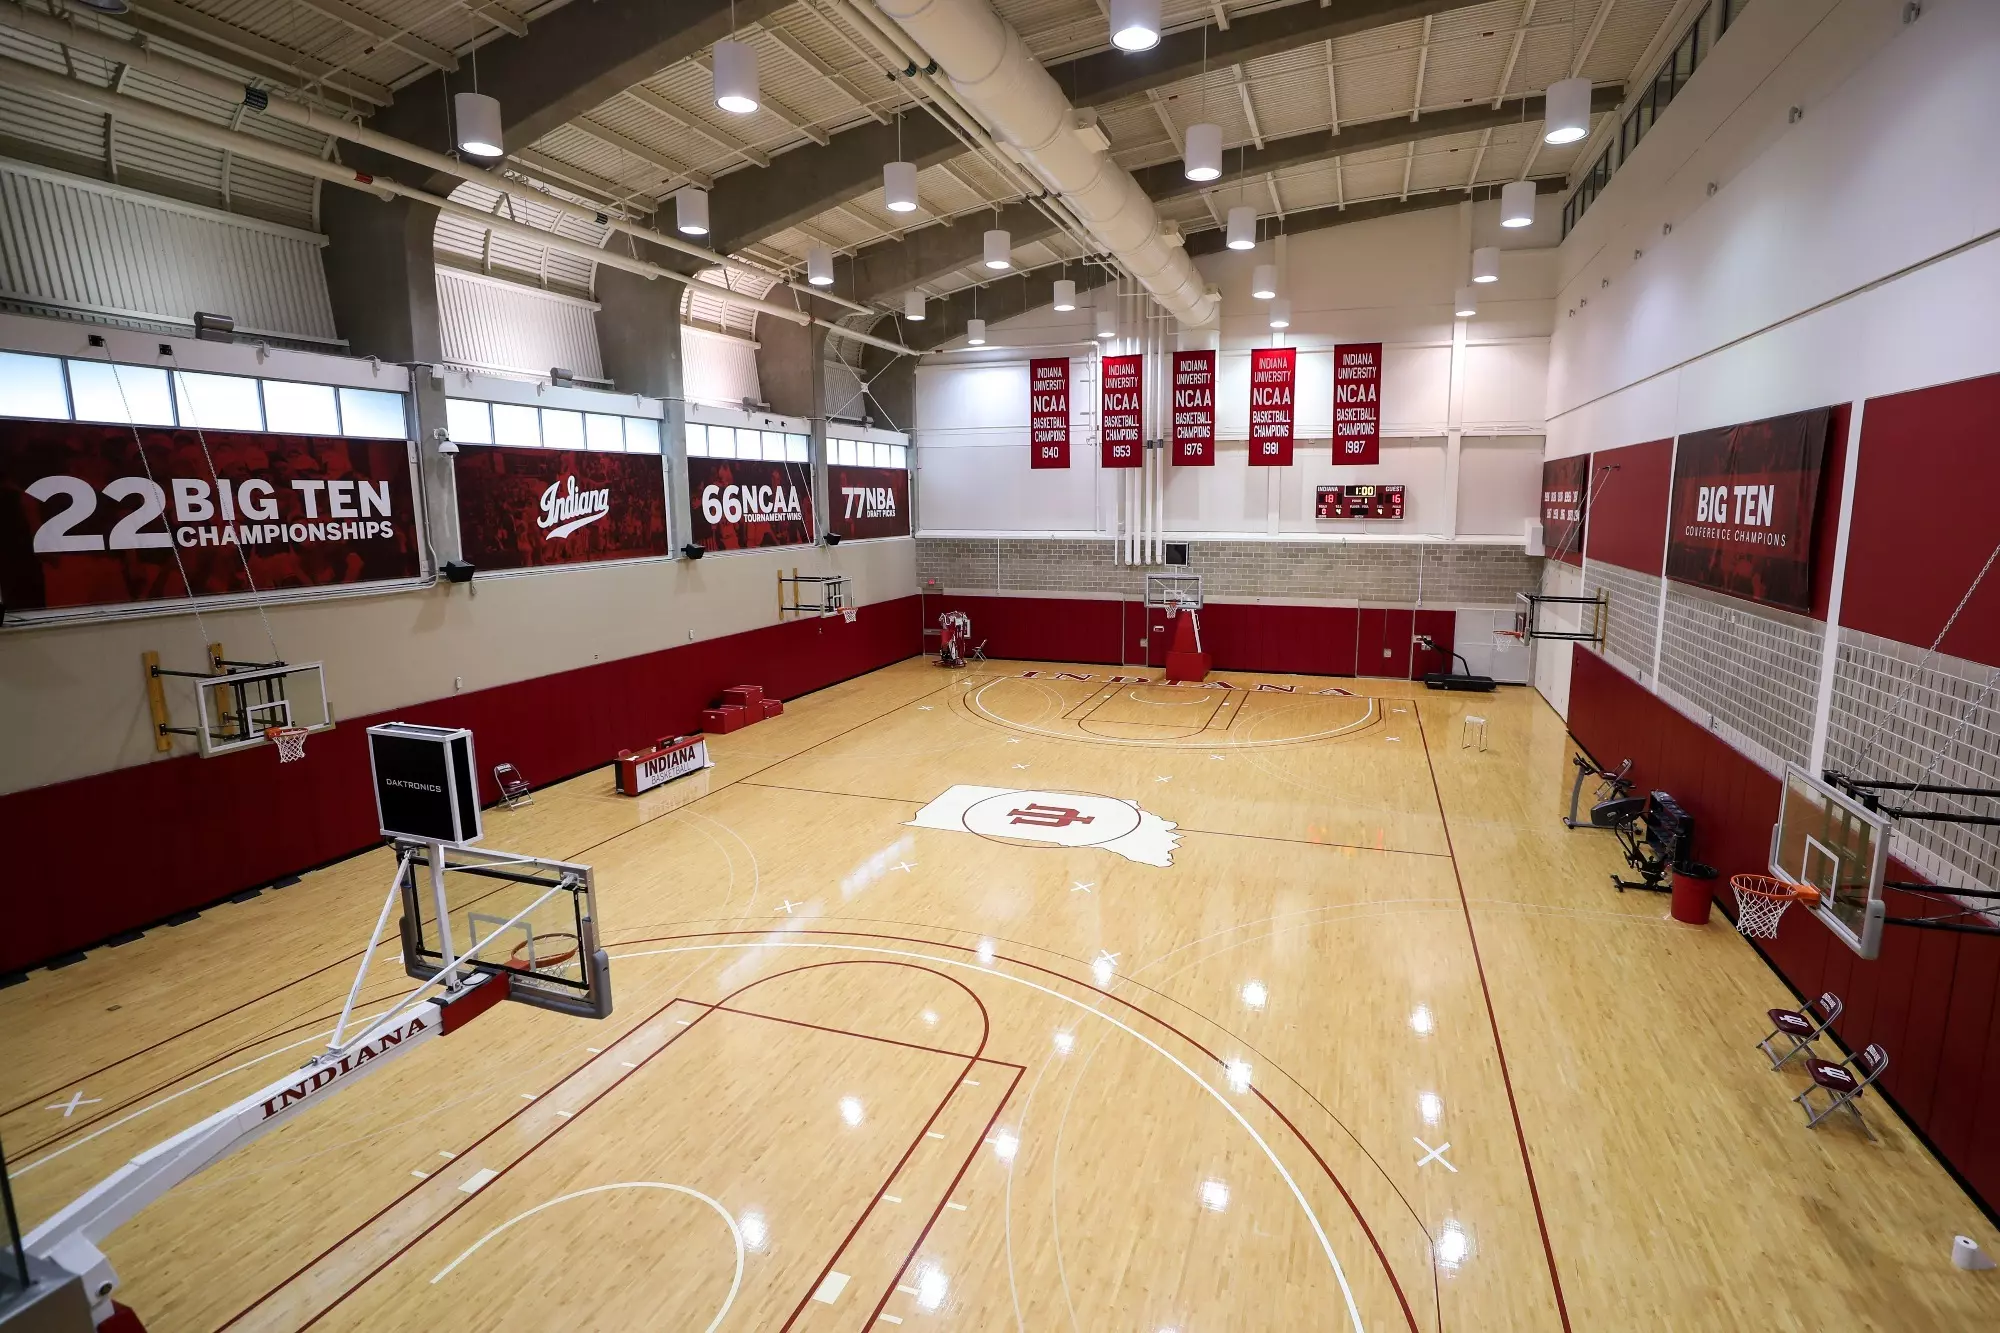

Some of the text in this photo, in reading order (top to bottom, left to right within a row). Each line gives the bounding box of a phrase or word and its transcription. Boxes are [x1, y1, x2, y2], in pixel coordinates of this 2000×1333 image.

[1259, 357, 1288, 369] INDIANA
[1343, 353, 1373, 365] INDIANA
[1037, 367, 1062, 378] INDIANA
[1109, 364, 1135, 375] INDIANA
[1181, 360, 1207, 372] INDIANA
[1338, 366, 1377, 379] UNIVERSITY
[1106, 377, 1138, 388] UNIVERSITY
[1177, 373, 1211, 384] UNIVERSITY
[1254, 370, 1291, 383] UNIVERSITY
[1034, 380, 1065, 391] UNIVERSITY
[1176, 389, 1212, 407] NCAA
[1253, 387, 1291, 406] NCAA
[1337, 384, 1376, 403] NCAA
[1034, 395, 1066, 412] NCAA
[1105, 393, 1139, 410] NCAA
[1104, 415, 1139, 427] BASKETBALL
[1176, 412, 1212, 424] BASKETBALL
[1253, 410, 1290, 423] BASKETBALL
[1337, 408, 1376, 421] BASKETBALL
[1034, 416, 1066, 428] BASKETBALL
[1106, 429, 1138, 441] CHAMPIONS
[1177, 426, 1210, 438] CHAMPIONS
[1254, 424, 1289, 438] CHAMPIONS
[1338, 422, 1374, 436] CHAMPIONS
[1035, 430, 1065, 442] CHAMPIONS
[1042, 447, 1058, 458] 1940
[1113, 445, 1130, 457] 1953
[1185, 443, 1202, 455] 1976
[1263, 442, 1278, 455] 1981
[1346, 441, 1365, 454] 1987
[1356, 487, 1373, 495] 1:00
[171, 478, 392, 522] BIG TEN
[537, 475, 609, 533] Indiana
[702, 485, 742, 524] 66
[742, 485, 801, 513] NCAA
[842, 487, 865, 518] 77
[866, 488, 895, 509] NBA
[1392, 494, 1400, 503] 16
[1697, 485, 1774, 526] BIG TEN
[24, 475, 175, 553] 22
[744, 512, 802, 522] TOURNAMENT WINS
[176, 520, 394, 548] CHAMPIONSHIPS
[1686, 526, 1786, 546] CONFERENCE CHAMPIONS
[1018, 670, 1364, 697] INDIANA
[645, 746, 695, 777] INDIANA
[652, 763, 691, 784] BASKETBALL
[386, 779, 441, 792] DAKTRONICS
[260, 1017, 428, 1120] INDIANA
